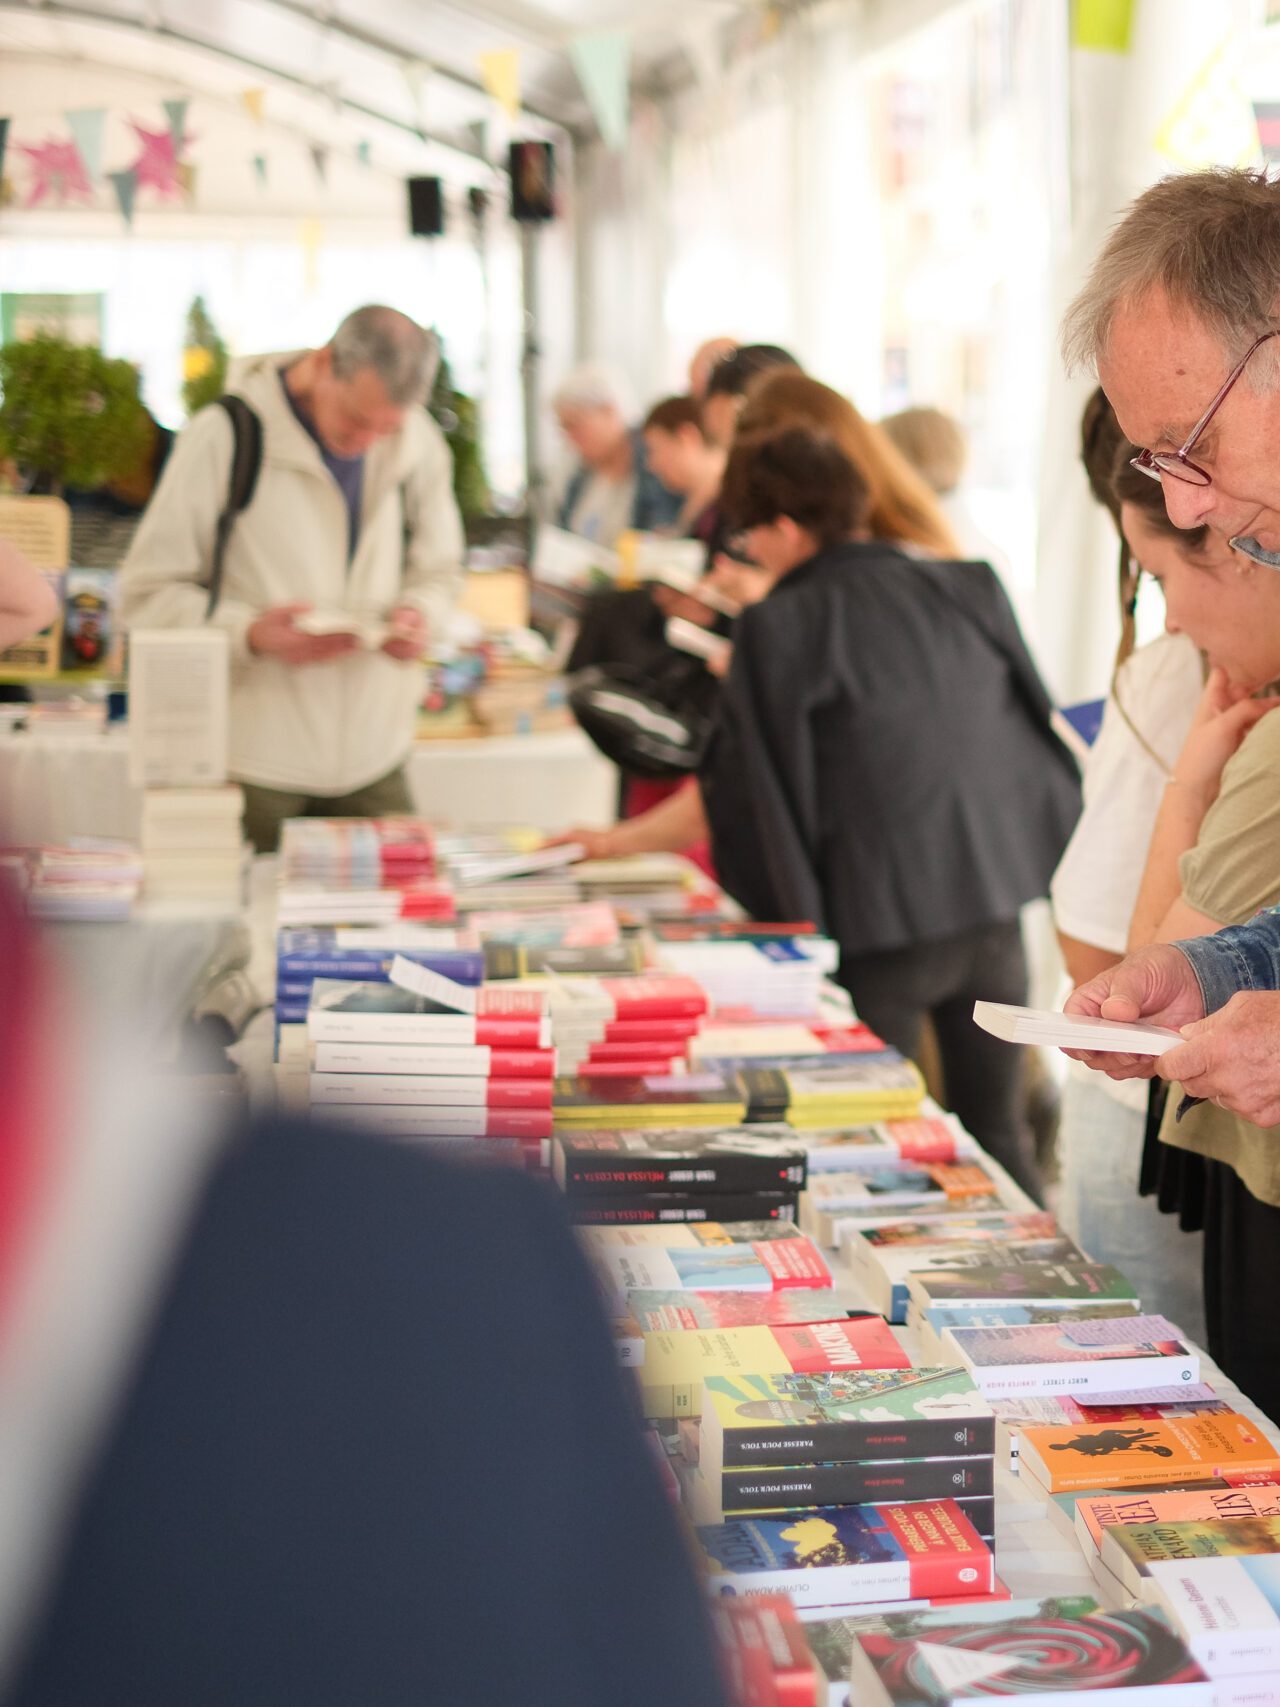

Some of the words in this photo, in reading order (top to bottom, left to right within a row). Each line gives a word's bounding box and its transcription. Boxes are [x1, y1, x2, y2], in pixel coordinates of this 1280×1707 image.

[809, 1323, 861, 1365] MAKINE
[741, 1442, 760, 1450] TOUS
[740, 1485, 760, 1493] TOUS
[761, 1484, 781, 1492] POUR
[782, 1483, 812, 1491] PARESSE
[1211, 1493, 1257, 1519] LES
[1091, 1503, 1117, 1529] TISTE
[1130, 1532, 1168, 1560] ATHIAS
[745, 1585, 775, 1595] ADAM
[776, 1583, 810, 1593] OLIVIER
